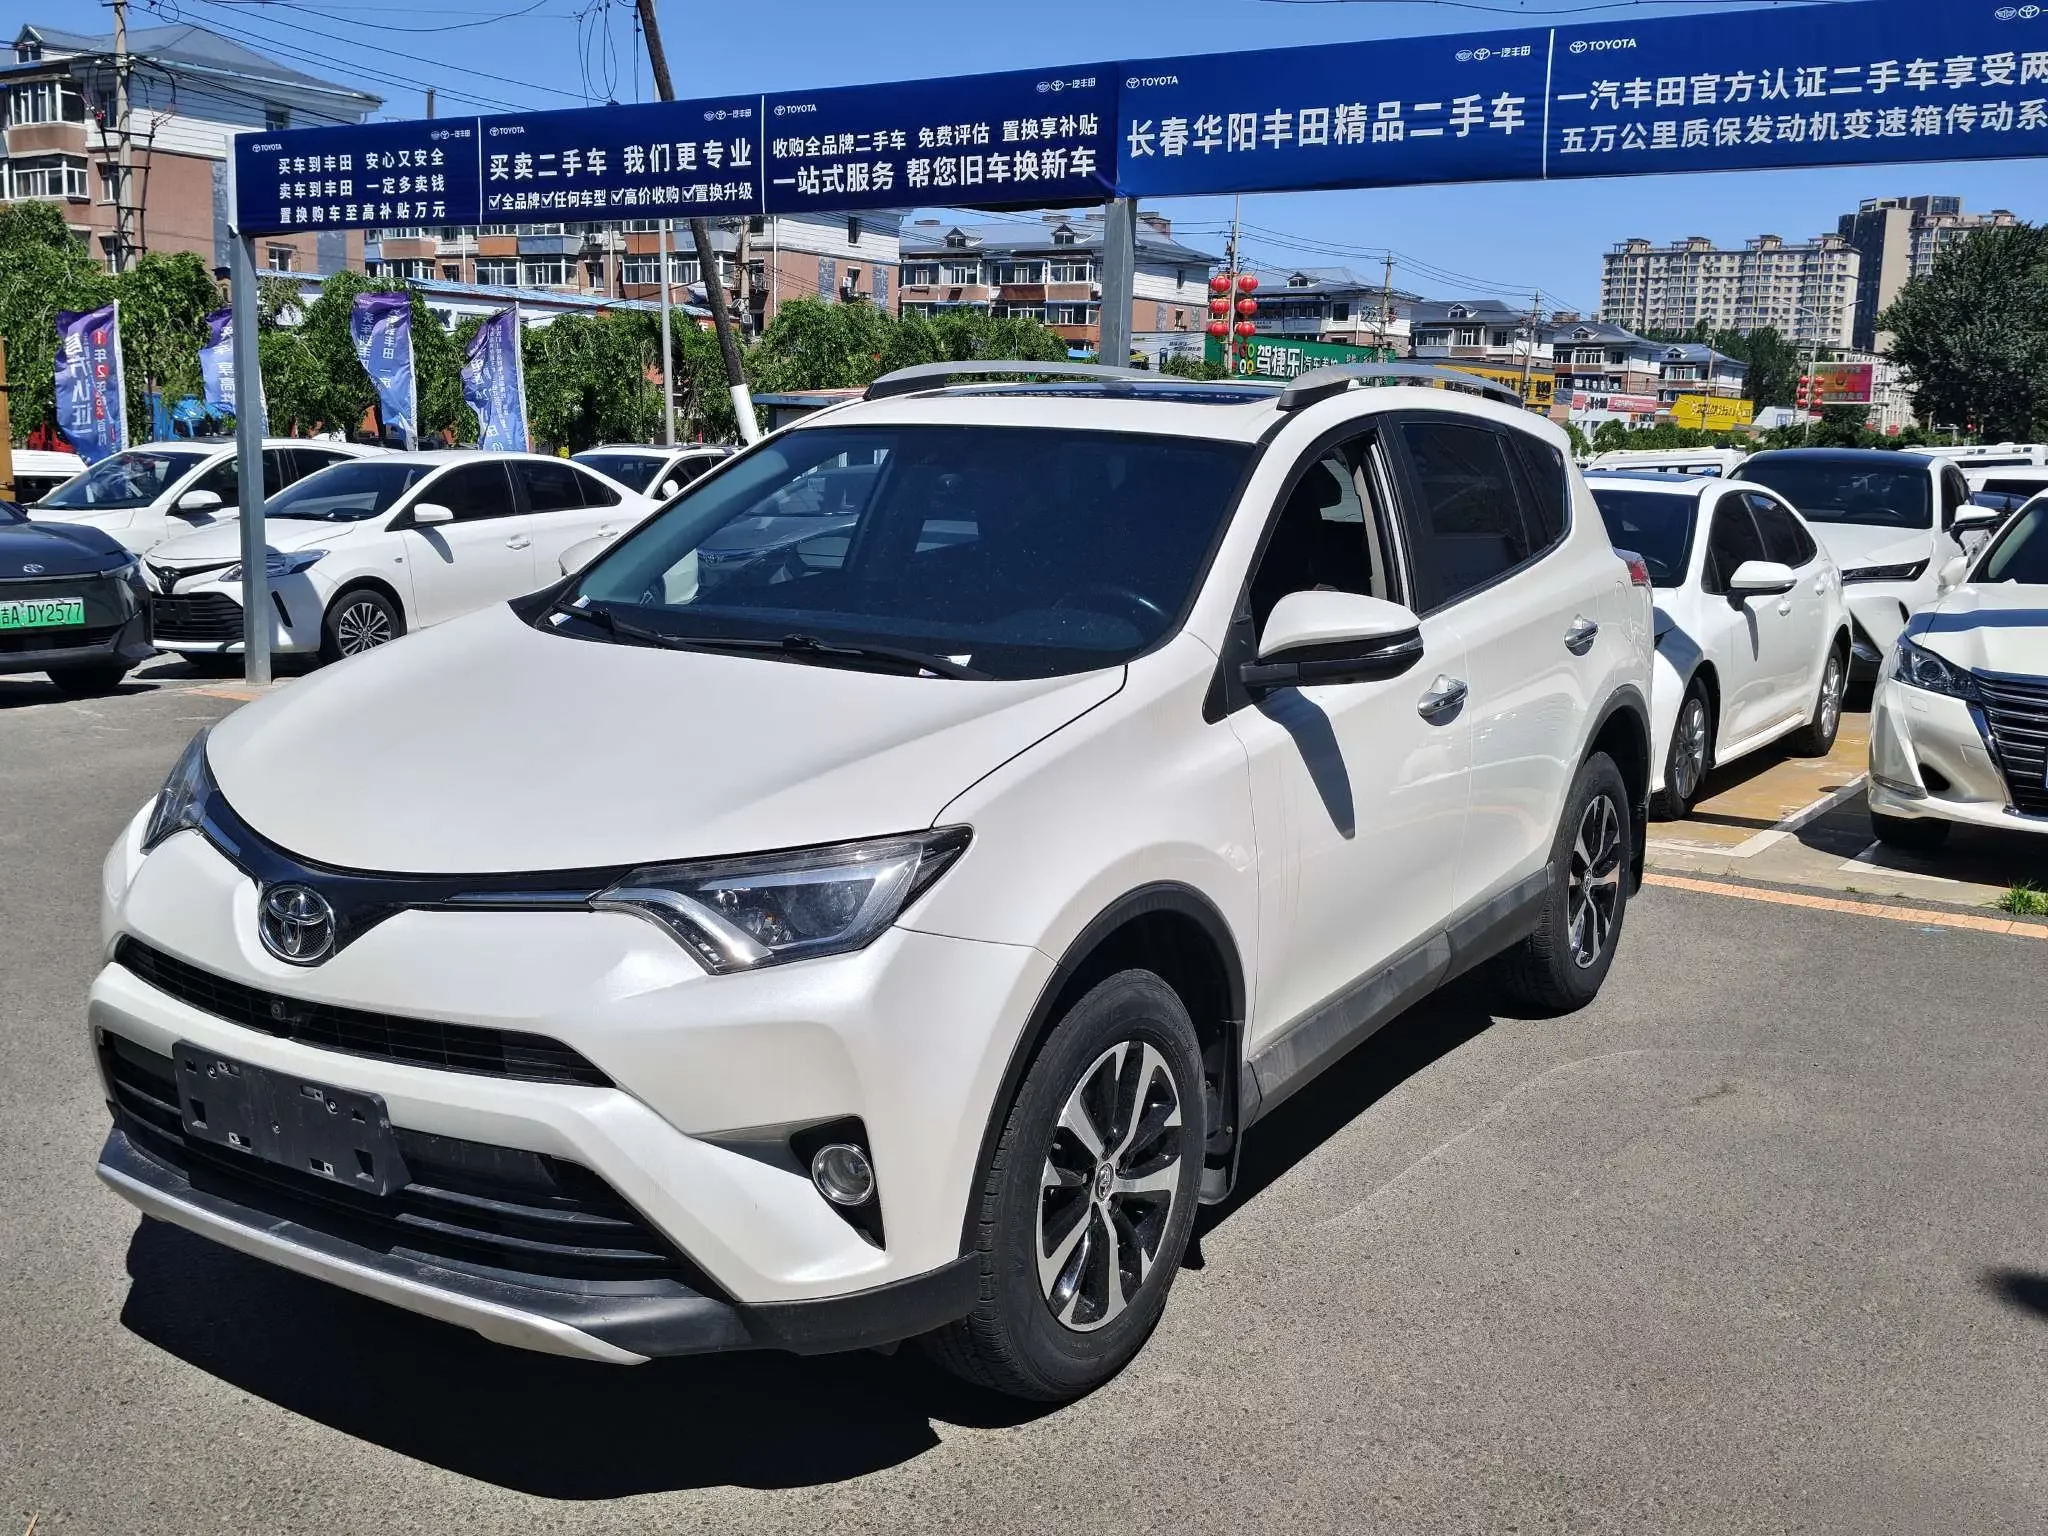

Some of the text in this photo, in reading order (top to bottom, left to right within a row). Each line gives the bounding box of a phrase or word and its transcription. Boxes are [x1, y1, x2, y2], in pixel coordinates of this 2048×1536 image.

[1589, 38, 1637, 51] TOYOTA
[1140, 76, 1179, 87] TOYOTA
[1558, 51, 2048, 111] 一汽丰田官方认证二手车享受两
[786, 103, 817, 114] TOYOTA
[499, 126, 525, 136] TOYOTA
[773, 112, 1099, 159] 收购全品牌二手车 免费评估 置换享补贴
[1127, 91, 1526, 159] 长春华阳丰田精品二手车
[1560, 97, 2048, 154] 五万公里质保发动机变速箱传动系
[261, 143, 283, 153] TOYOTA
[279, 147, 444, 176] 买车到丰田 安心又安全
[490, 138, 752, 181] 买卖二手车 我们更专业
[773, 145, 1097, 195] 一站式服务 帮您旧车换新车
[280, 174, 445, 199] 卖车到丰田 一定多卖钱
[502, 181, 753, 210] 全品牌 任何车型 高价收购 置换升级
[280, 200, 446, 224] 置换购车至高补贴万元
[28, 602, 82, 624] DY2577
